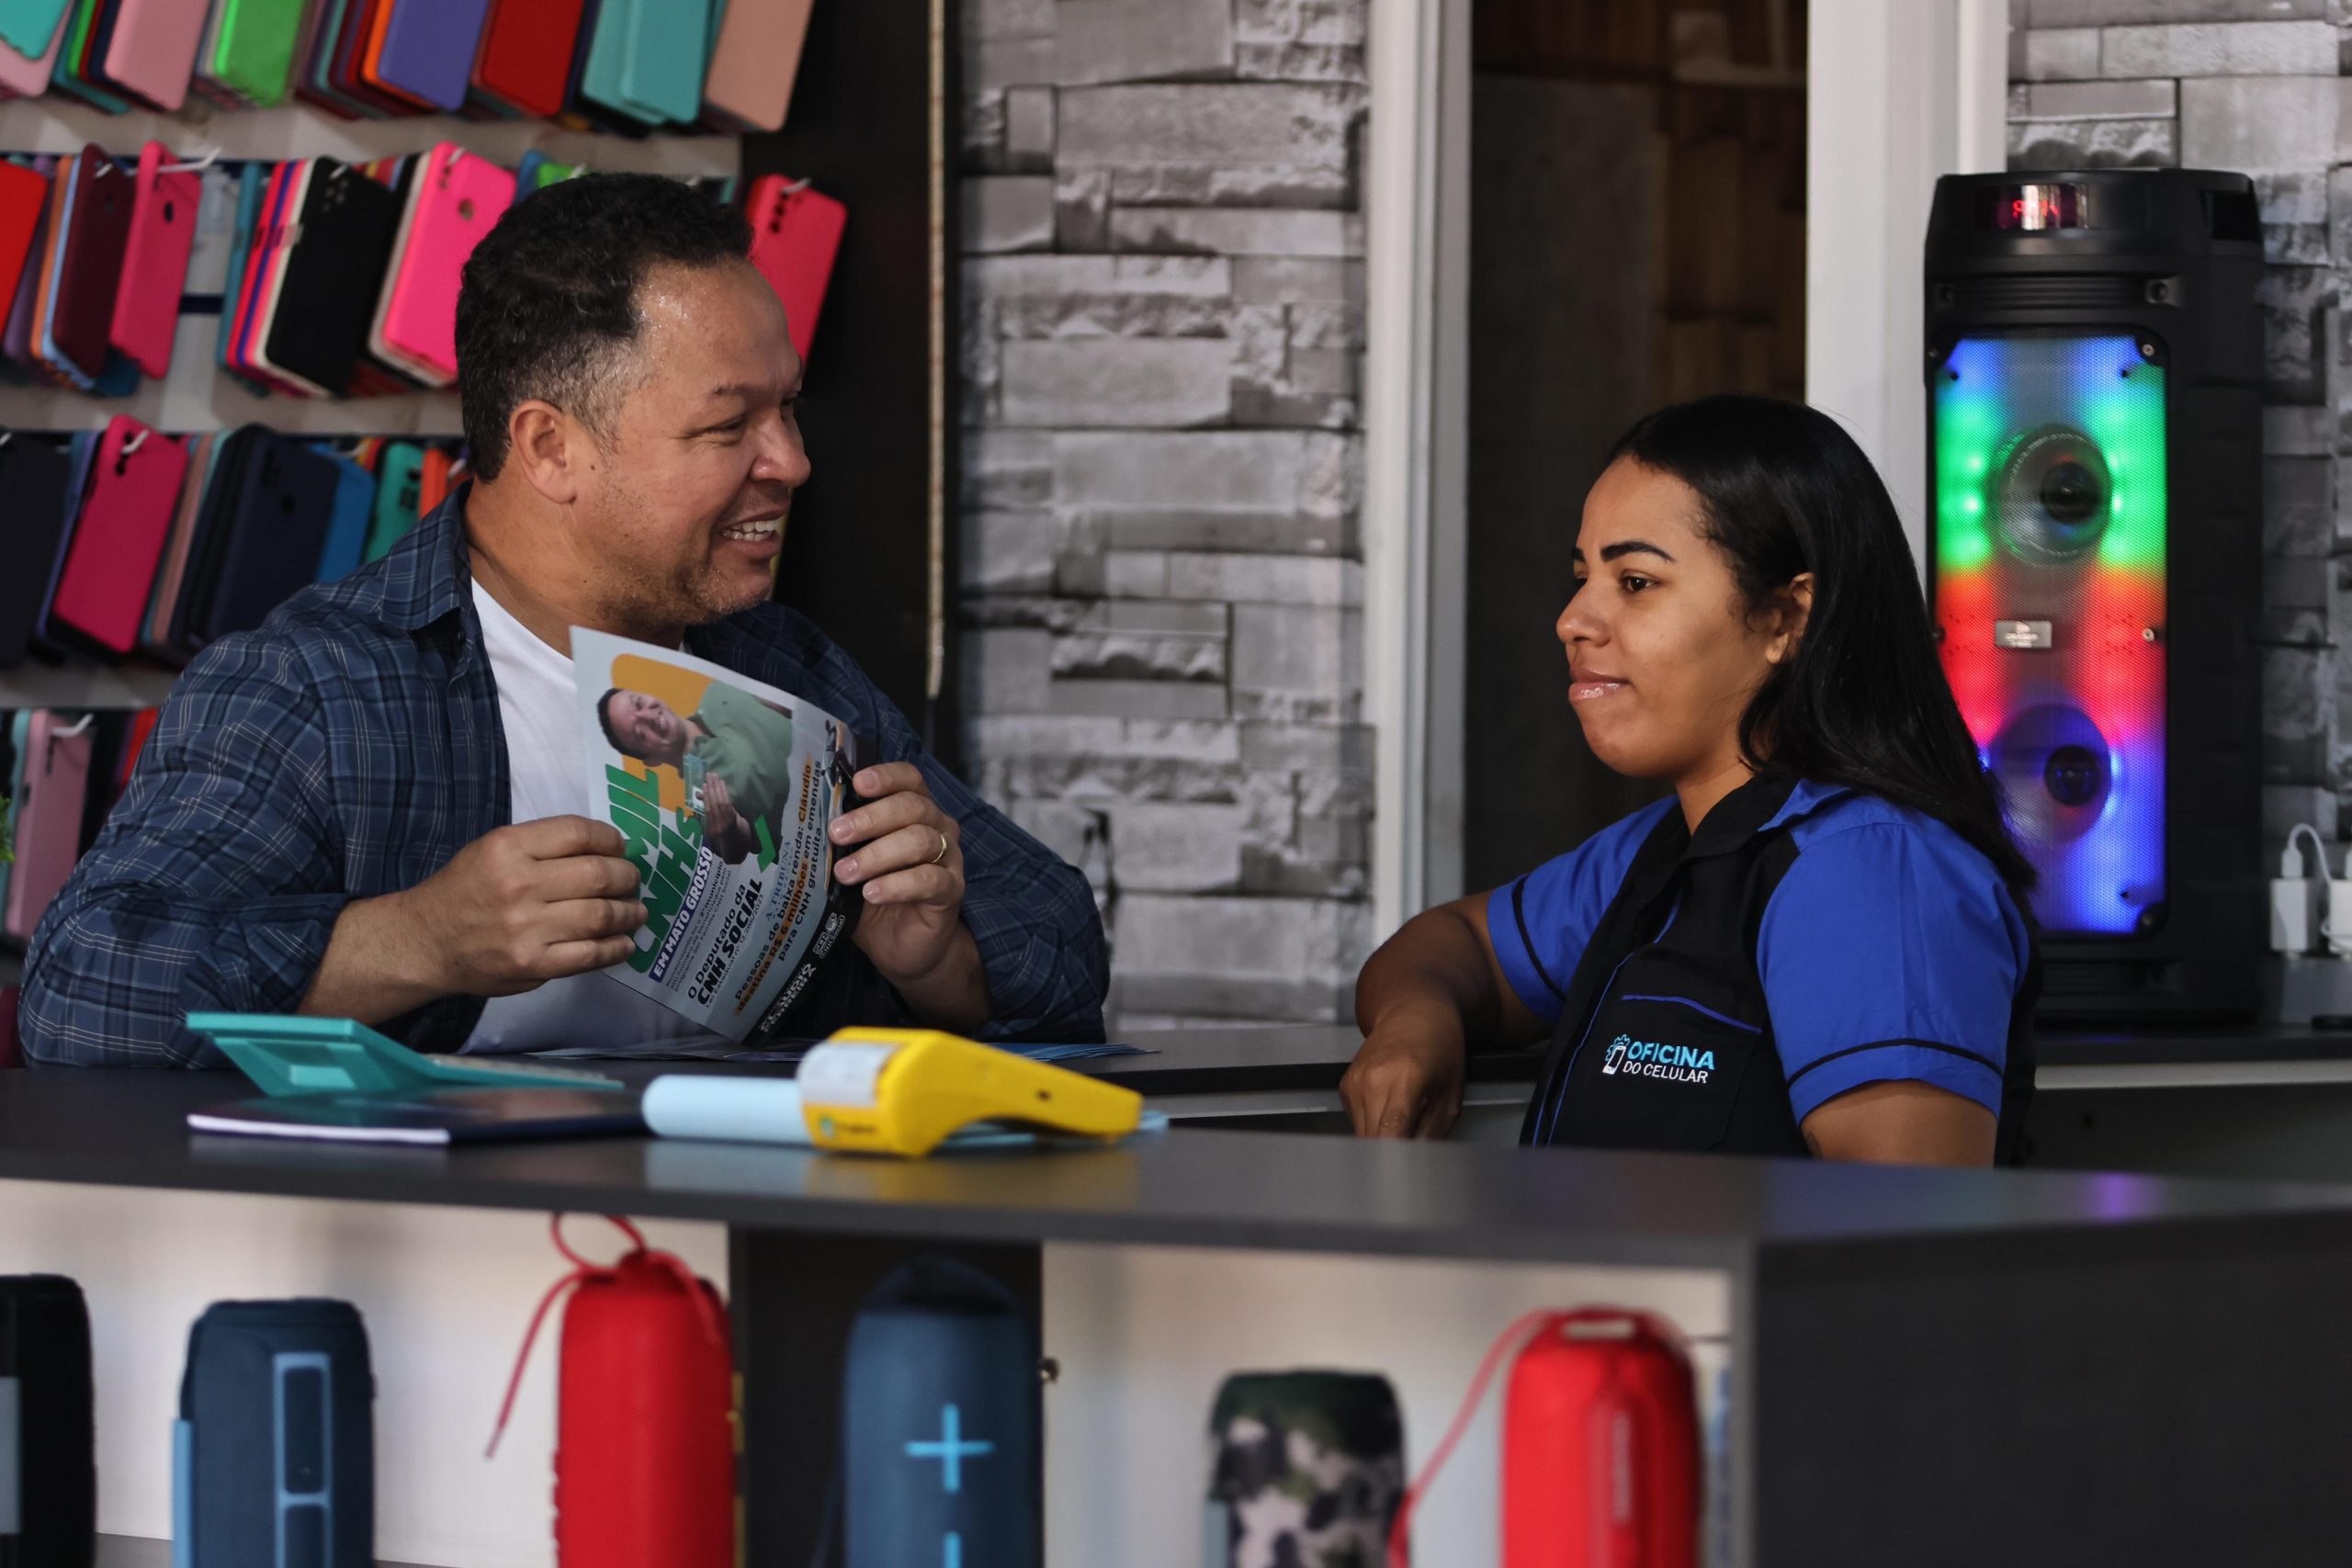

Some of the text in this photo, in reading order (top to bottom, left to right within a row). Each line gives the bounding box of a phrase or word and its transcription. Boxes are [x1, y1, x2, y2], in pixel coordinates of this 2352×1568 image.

[807, 761, 822, 830] emendas
[772, 841, 791, 905] TRIBUNA
[804, 834, 811, 860] em
[653, 846, 714, 977] EM MATO GROSSO
[735, 944, 769, 999] Pessoas
[768, 922, 780, 941] de
[776, 879, 796, 919] baixa
[791, 826, 804, 875] renda:
[778, 929, 797, 962] para
[795, 892, 811, 925] CNH
[808, 827, 823, 889] gratuita
[787, 863, 808, 923] milhões
[688, 885, 746, 998] O Deputado da
[697, 878, 763, 1005] CNH SOCIAL
[769, 939, 782, 957] R$
[780, 925, 788, 934] 6
[714, 956, 736, 993] Estadual
[738, 961, 771, 1011] destina
[1623, 1061, 1709, 1084] DO CELULAR
[1627, 1041, 1715, 1070] OFICINA
